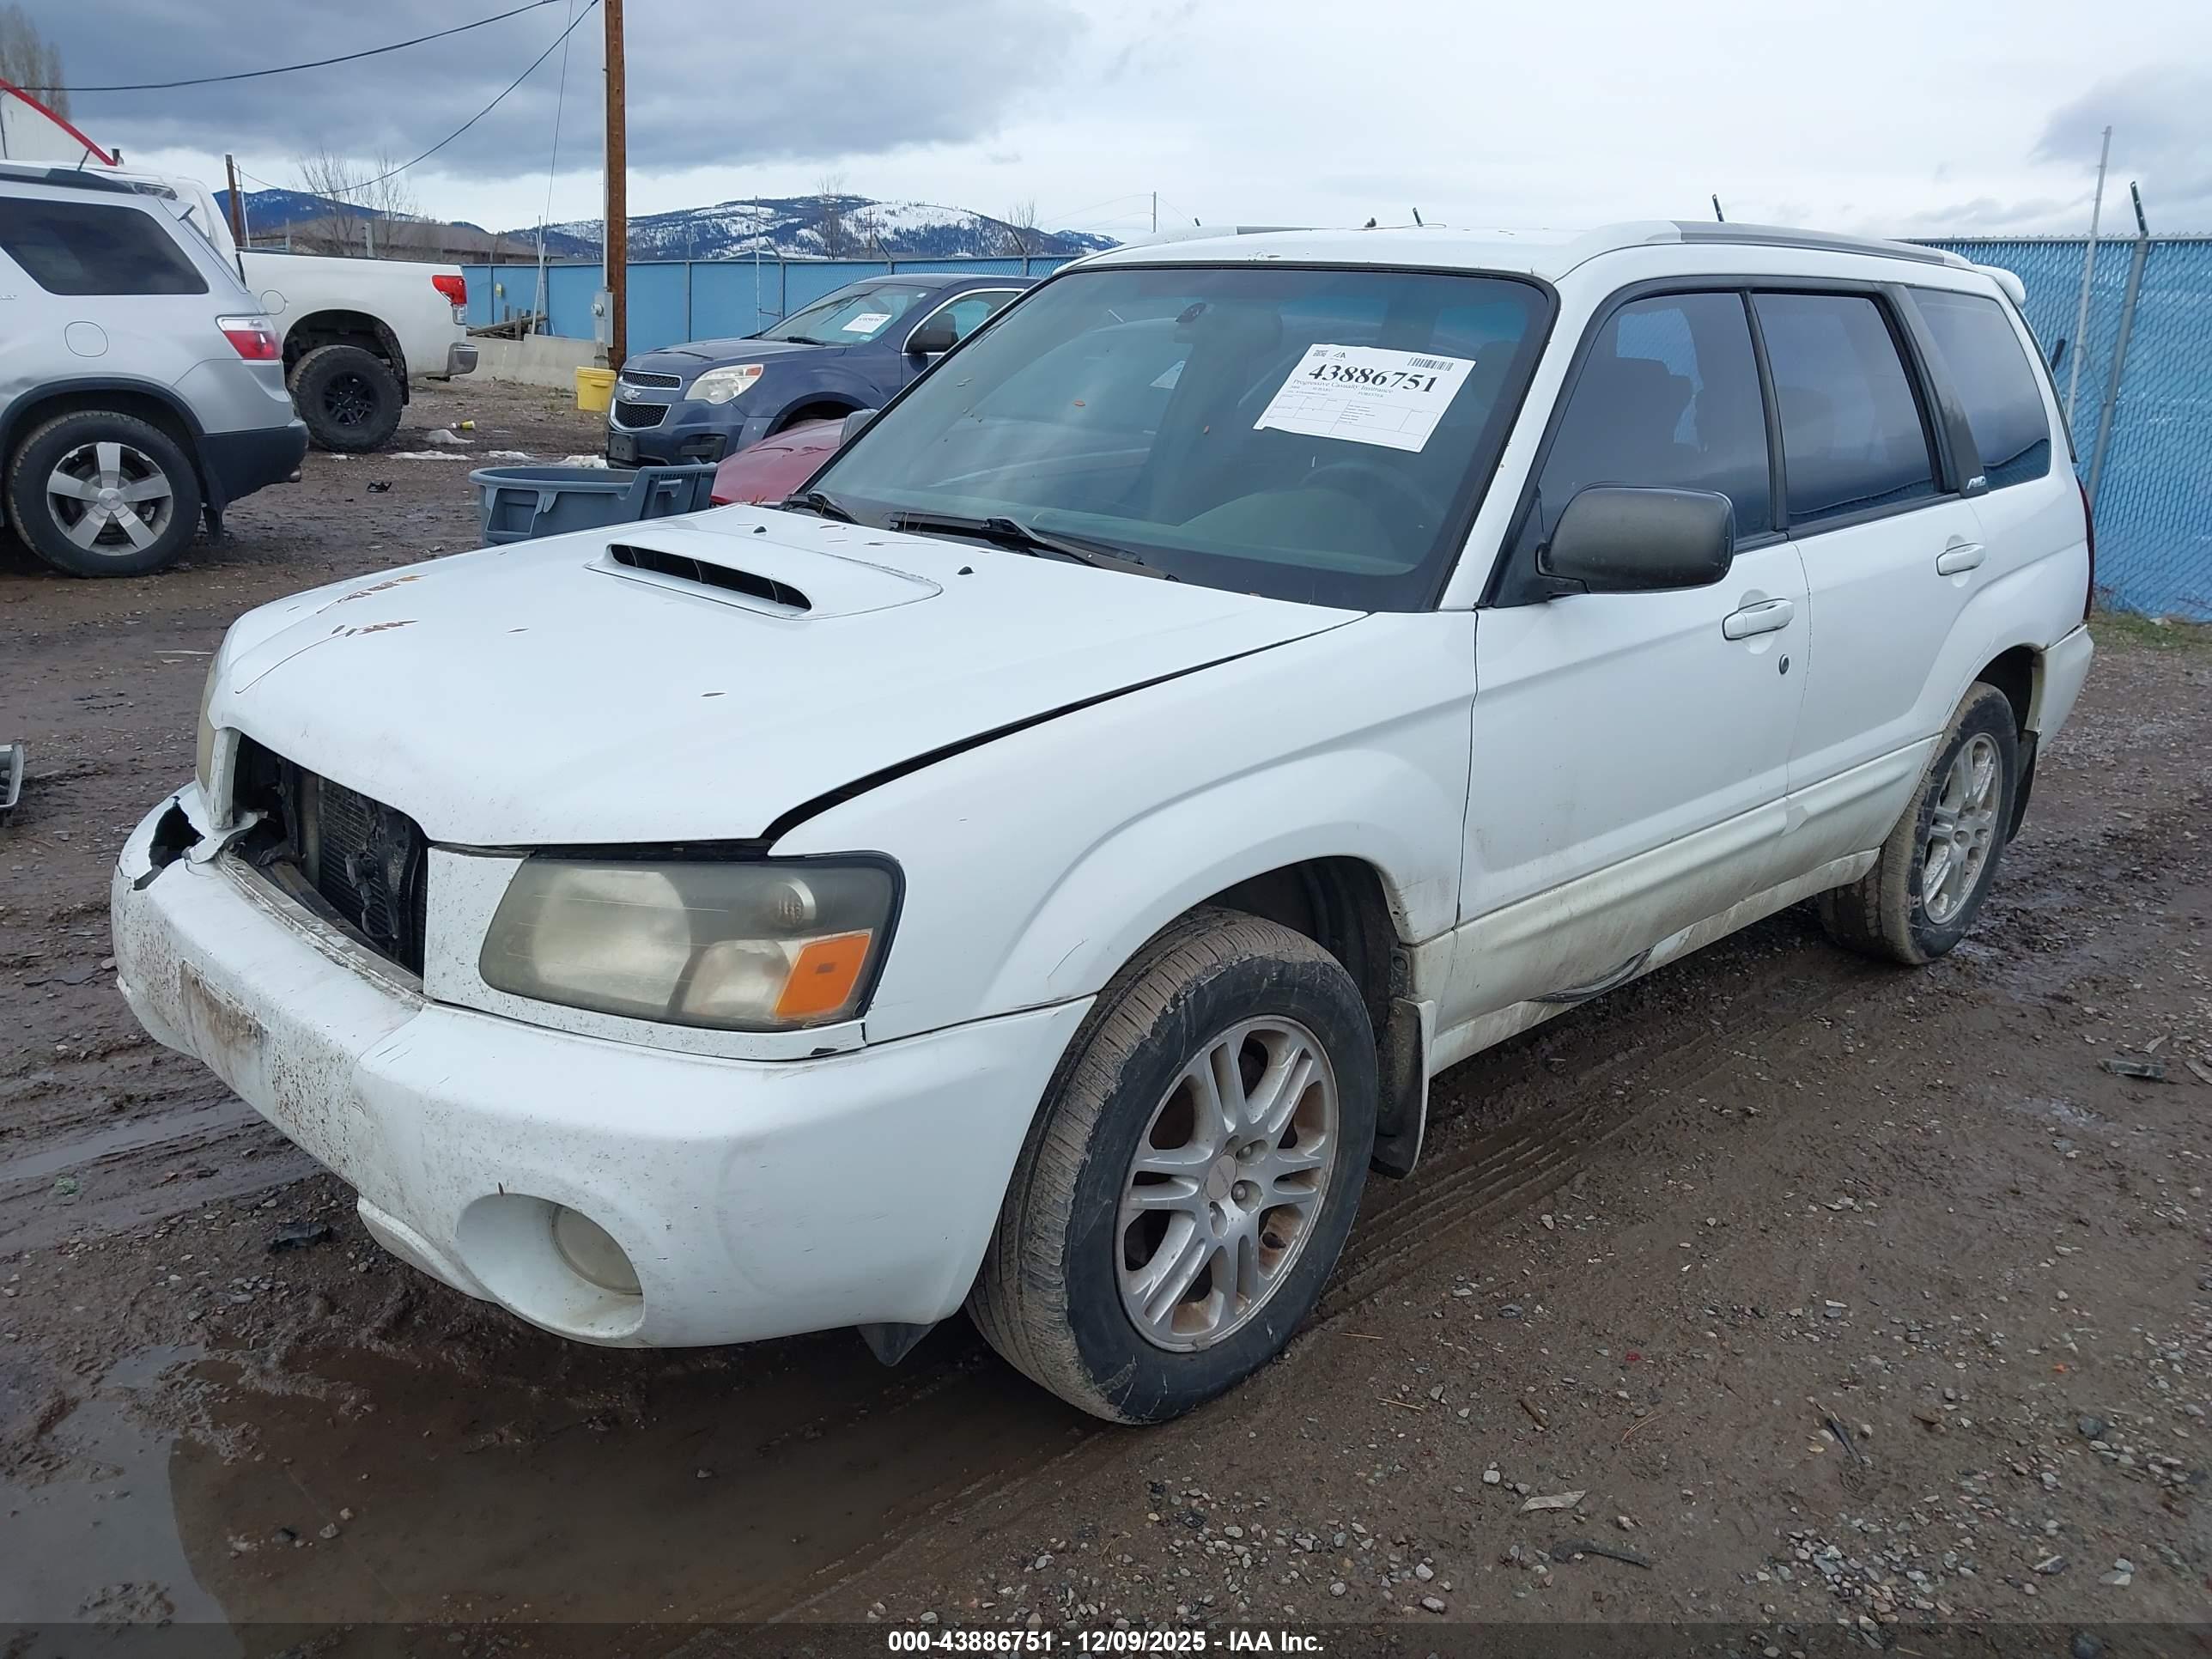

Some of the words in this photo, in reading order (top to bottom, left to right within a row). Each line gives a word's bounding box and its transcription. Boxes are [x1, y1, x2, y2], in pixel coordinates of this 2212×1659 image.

[1293, 379, 1330, 387] Progressive
[1331, 382, 1359, 391] Casualty
[1360, 385, 1395, 394] Insurance
[1308, 363, 1438, 393] 43886751
